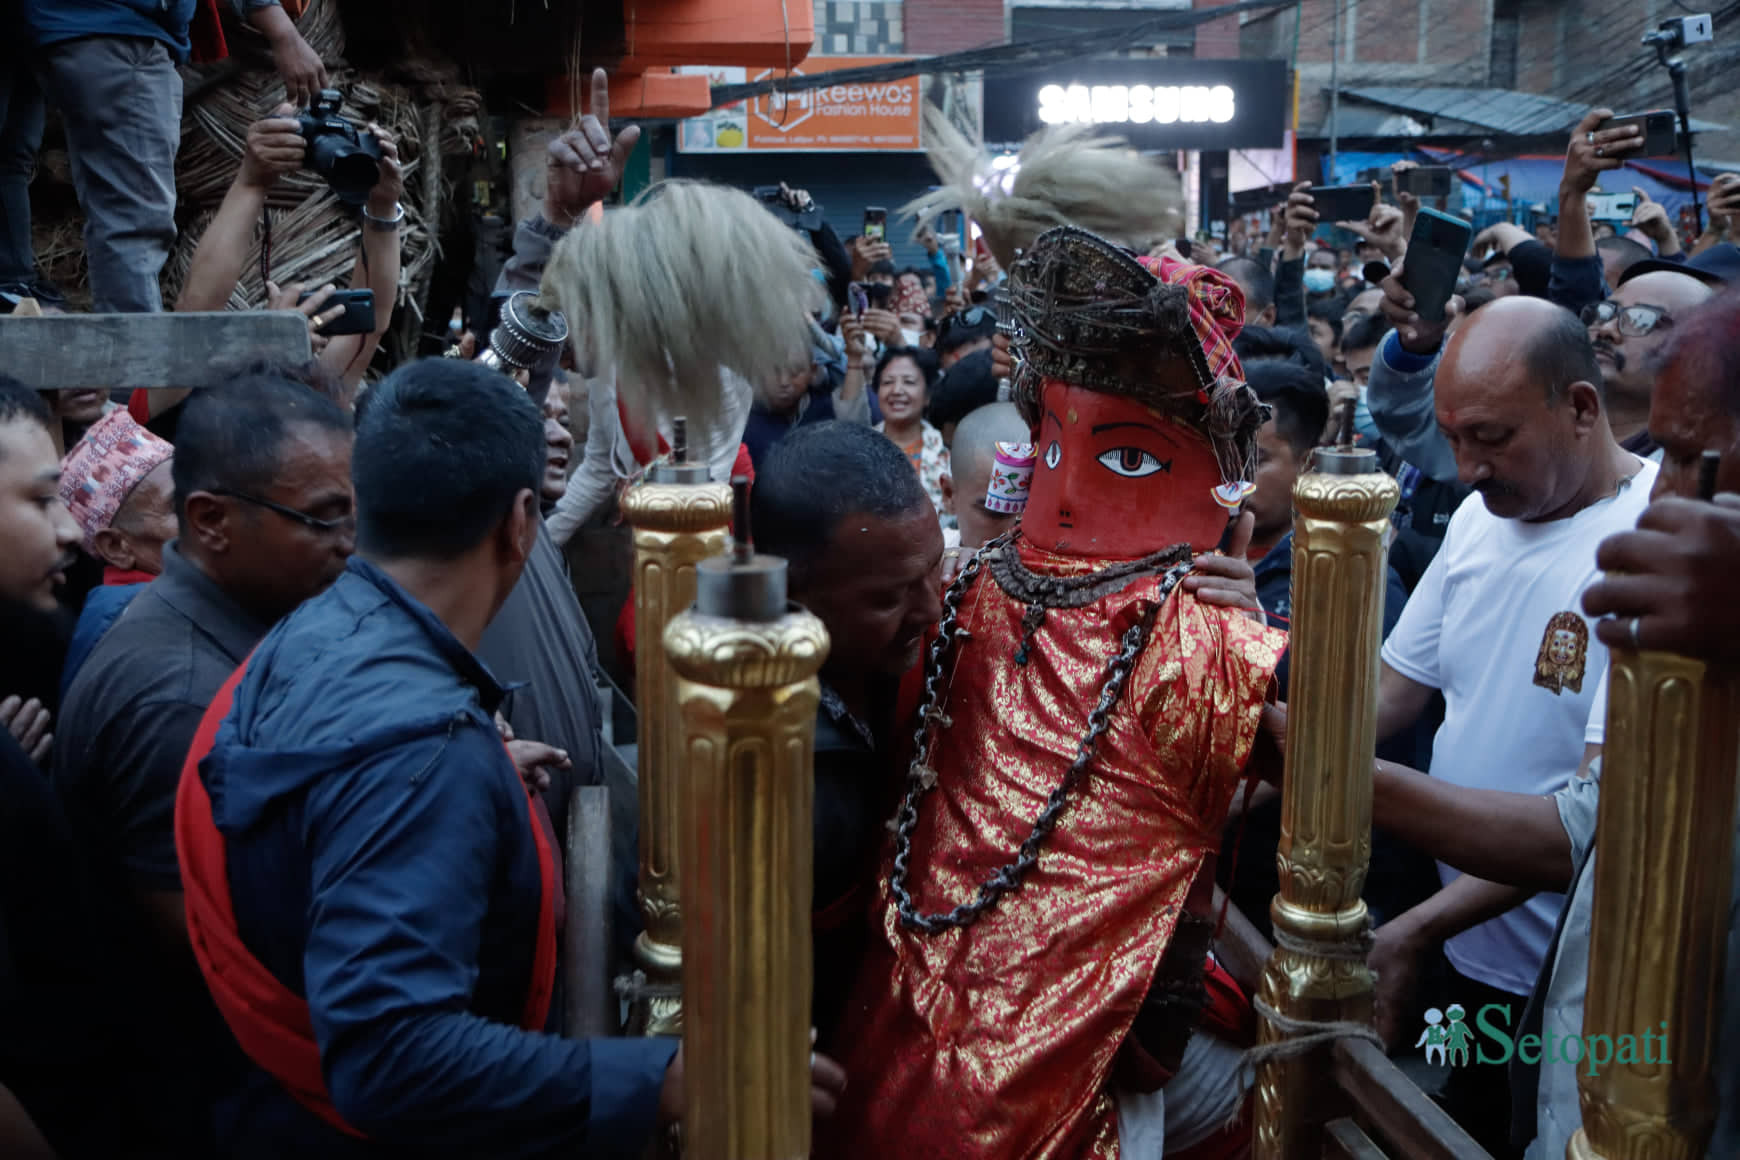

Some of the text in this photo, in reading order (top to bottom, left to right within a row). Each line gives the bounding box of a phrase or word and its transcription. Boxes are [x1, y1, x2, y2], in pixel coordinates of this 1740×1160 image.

[816, 103, 911, 116] Fashion House
[1038, 84, 1235, 124] SAMSUNG
